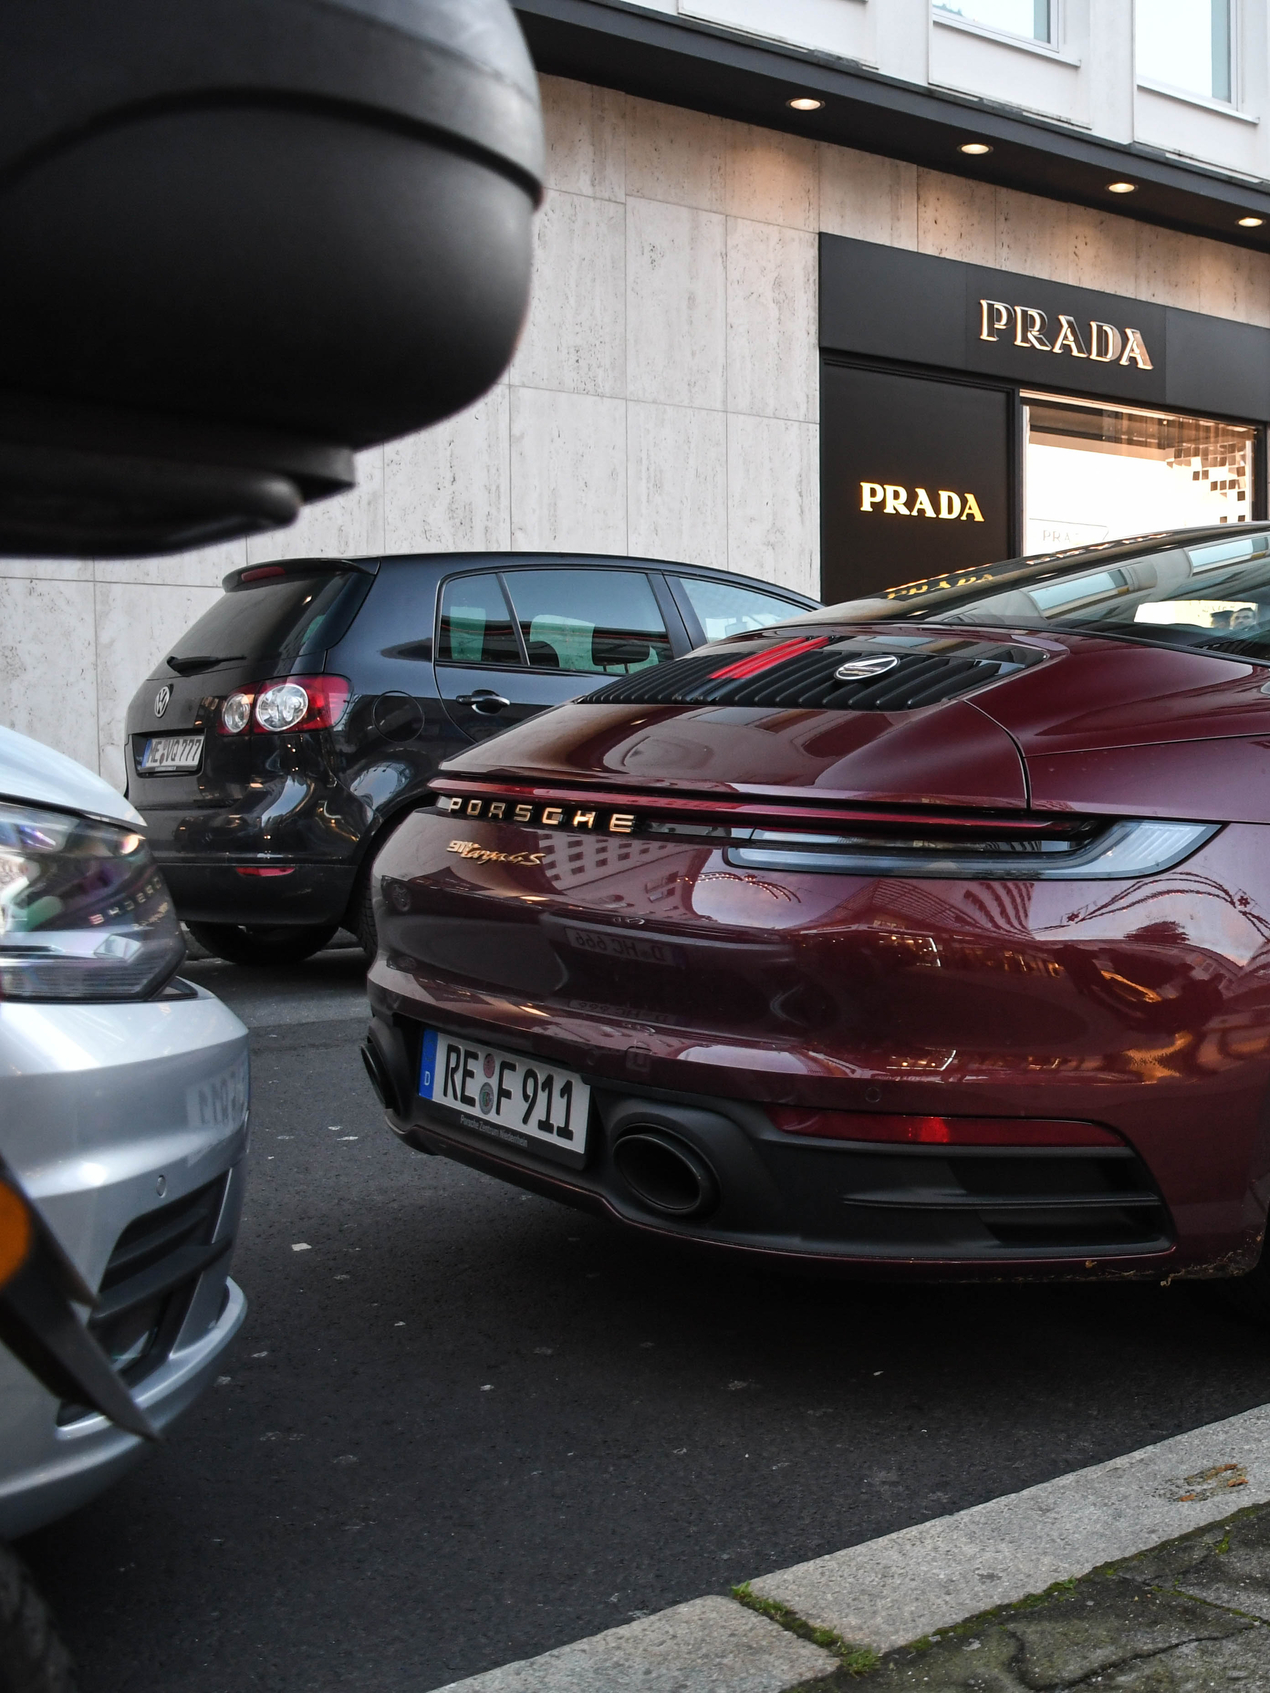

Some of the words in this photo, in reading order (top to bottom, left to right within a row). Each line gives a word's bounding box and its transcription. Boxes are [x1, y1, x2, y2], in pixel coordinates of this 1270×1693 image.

[980, 299, 1154, 370] PRADA
[860, 481, 985, 522] PRADA
[180, 738, 202, 762] 777
[448, 797, 635, 833] PORSCHE
[443, 1044, 480, 1108] RE
[496, 1060, 518, 1116] F
[522, 1068, 574, 1142] 911
